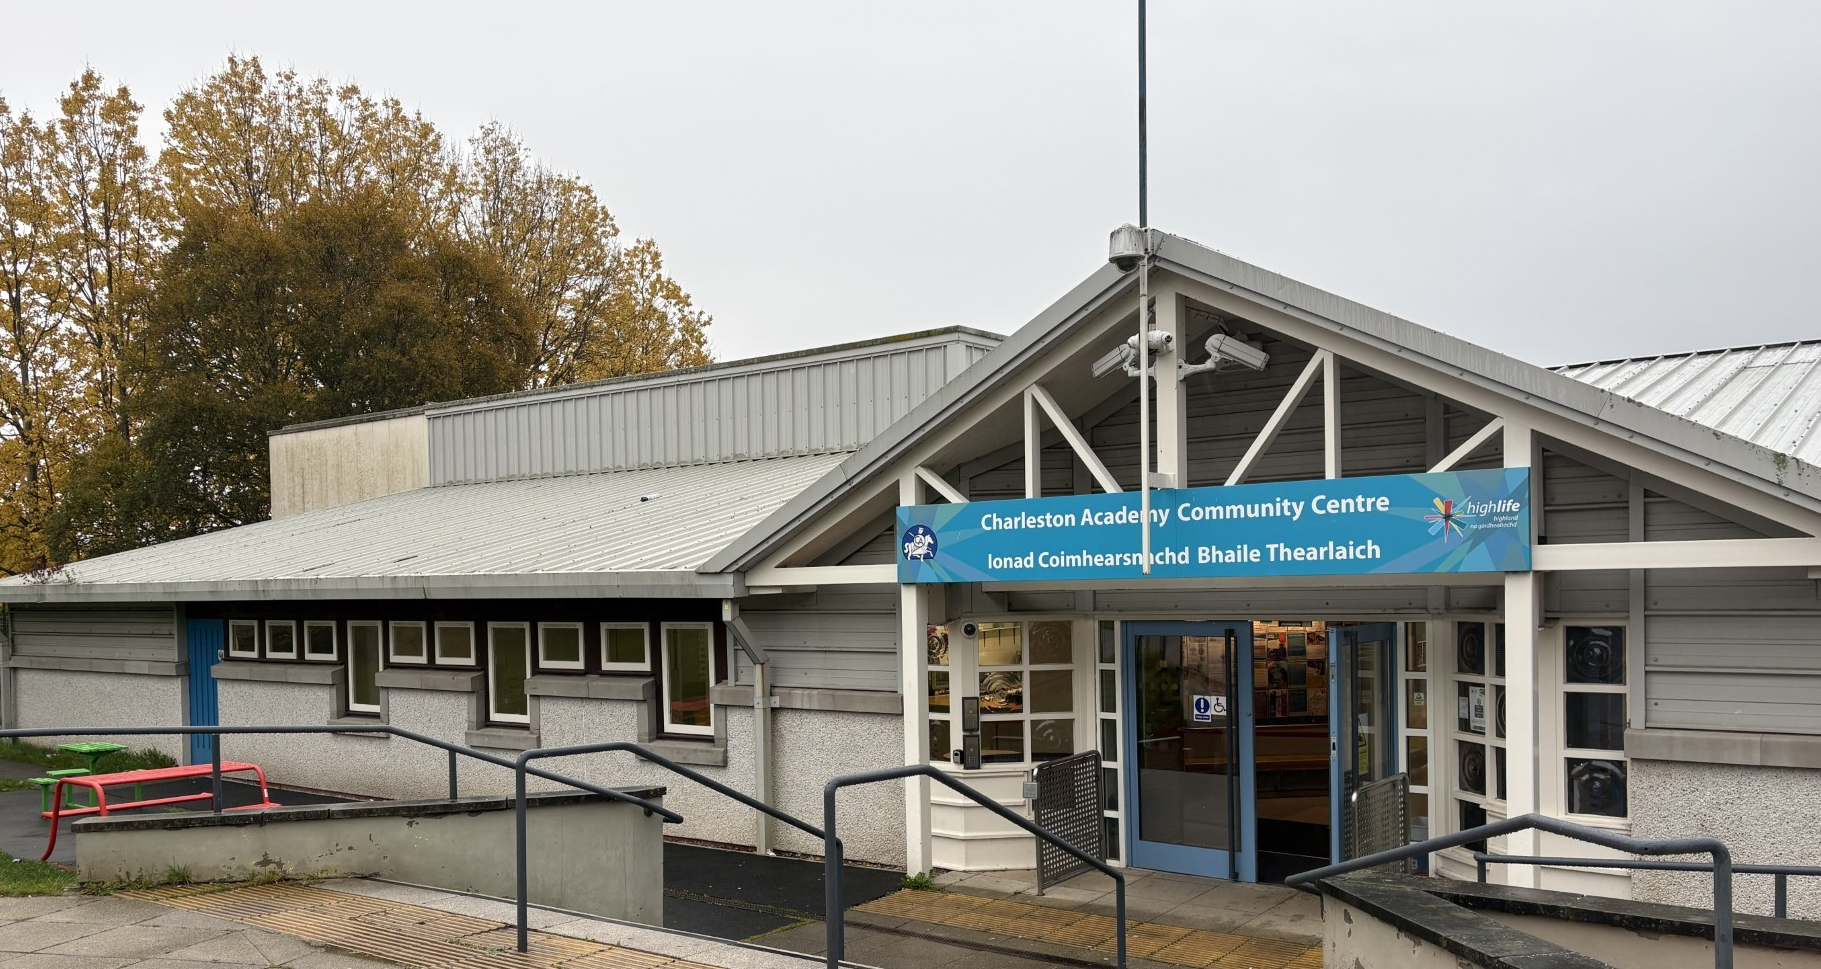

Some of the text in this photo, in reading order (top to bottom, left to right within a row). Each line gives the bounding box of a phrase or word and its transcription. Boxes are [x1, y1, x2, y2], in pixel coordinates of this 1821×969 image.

[981, 494, 1390, 531] Charleston Academy Community Centre
[1467, 499, 1520, 516] highlife
[988, 551, 1034, 569] Ionad
[1198, 544, 1261, 563] Bhaile
[1265, 540, 1381, 561] Thearlaich
